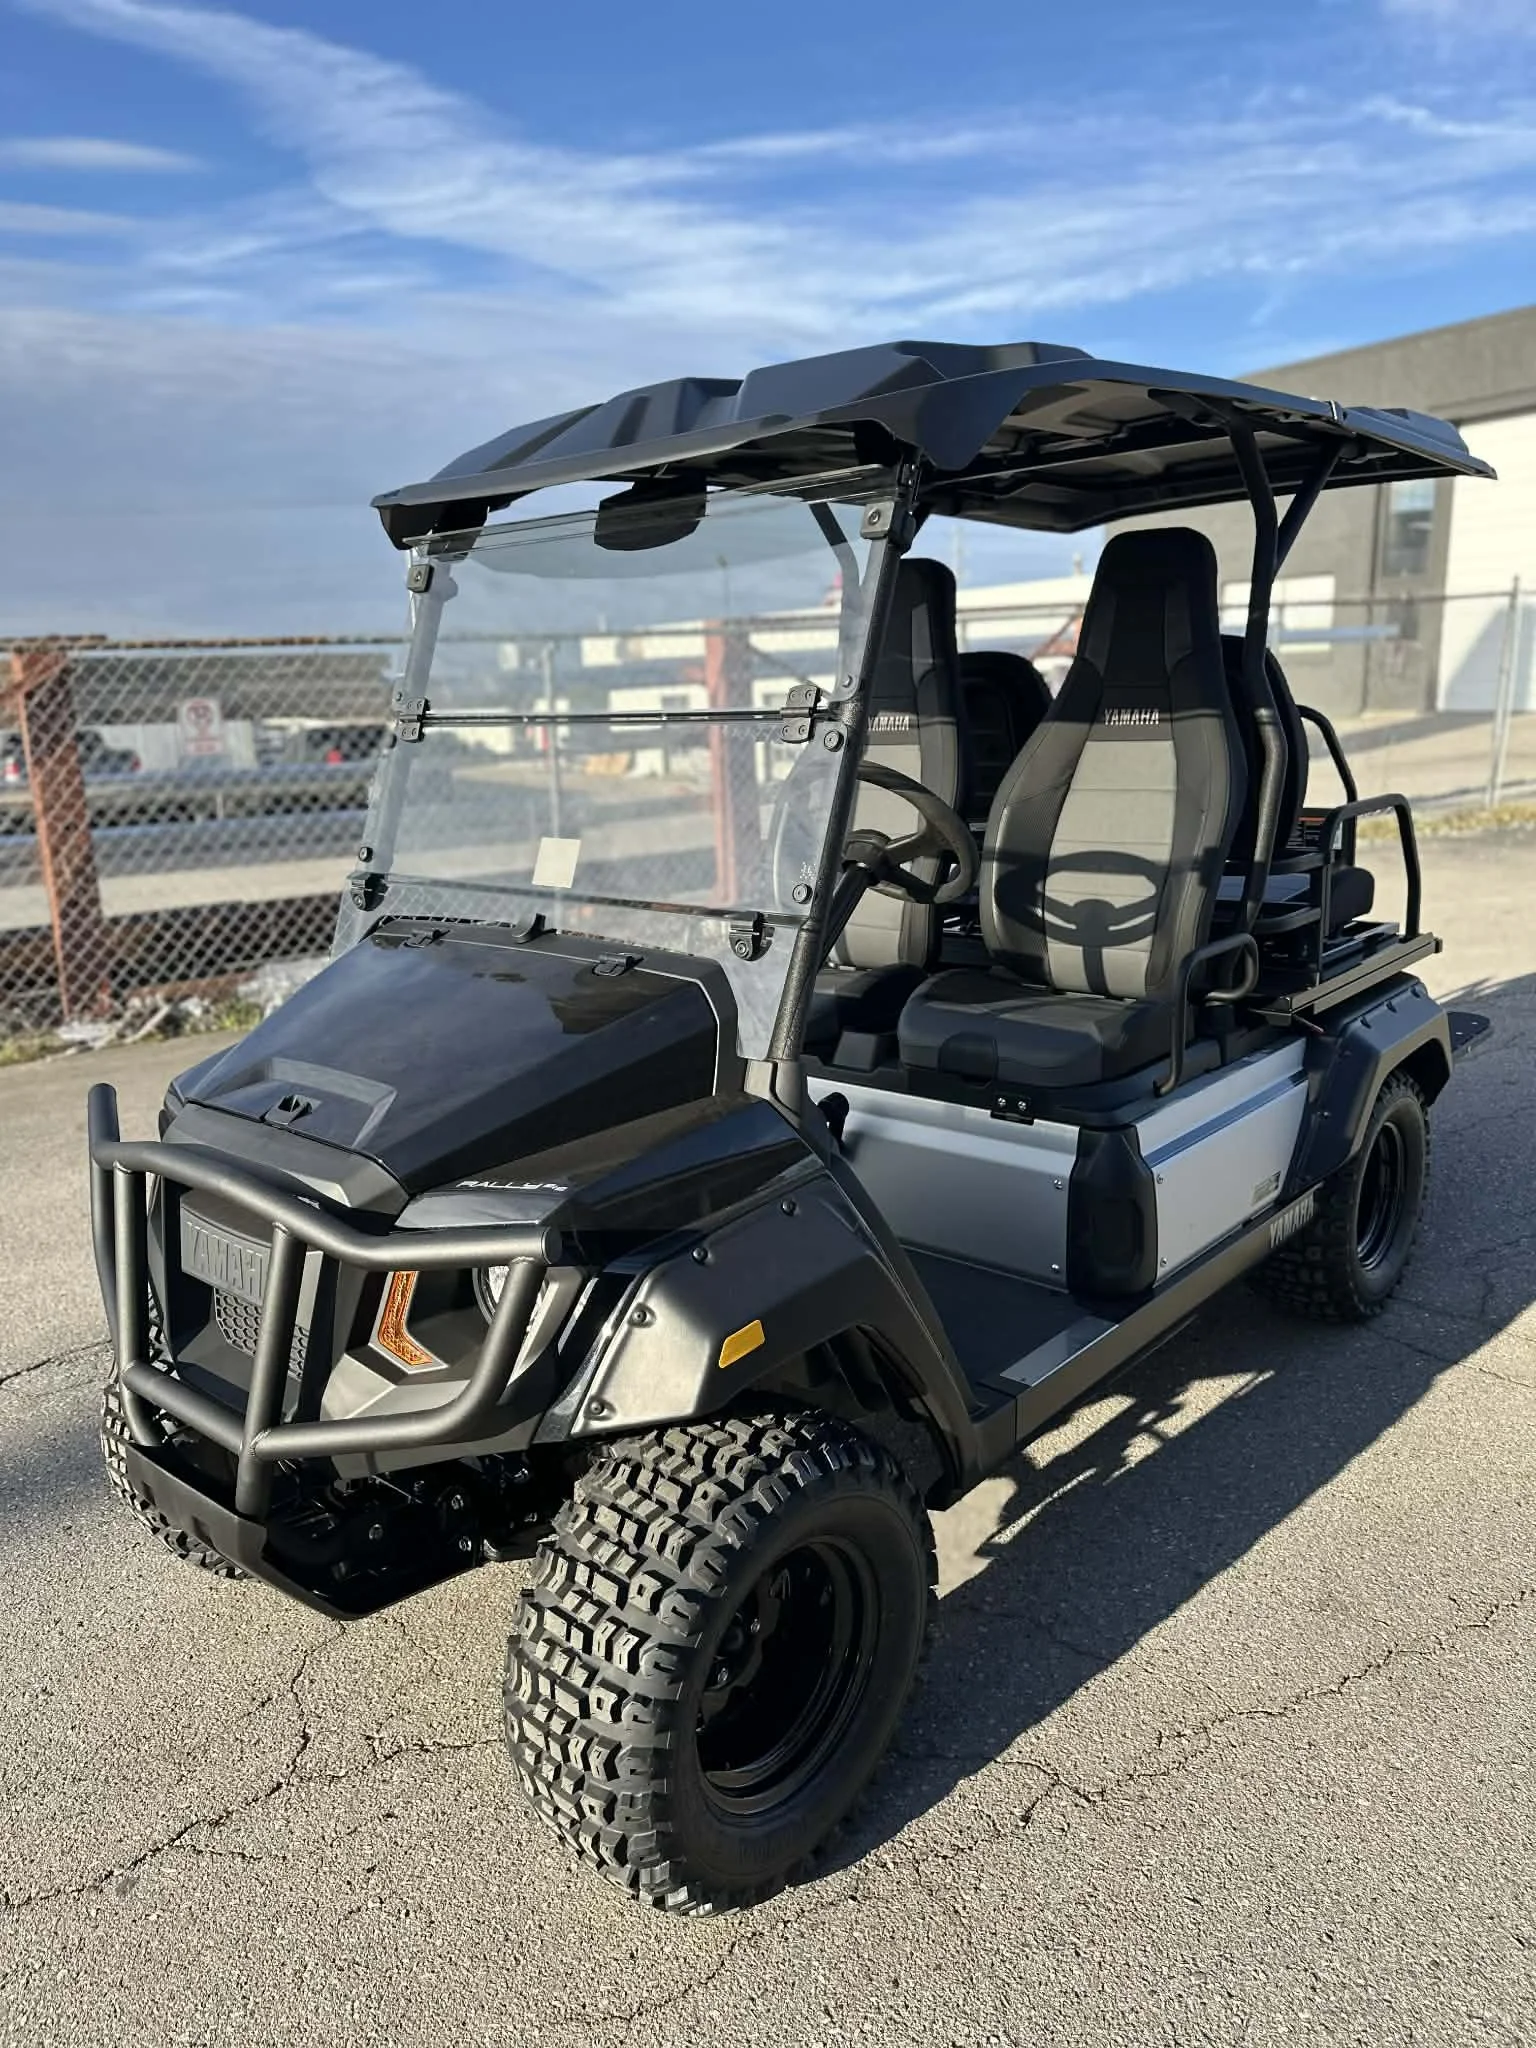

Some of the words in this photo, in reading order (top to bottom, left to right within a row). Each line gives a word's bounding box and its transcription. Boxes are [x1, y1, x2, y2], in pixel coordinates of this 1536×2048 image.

[867, 715, 910, 731] YAMAHA
[1104, 708, 1160, 725] YAMAHA
[455, 1180, 543, 1190] RALLY
[1269, 1191, 1314, 1249] YAMAHA
[185, 1221, 264, 1299] YAMAH
